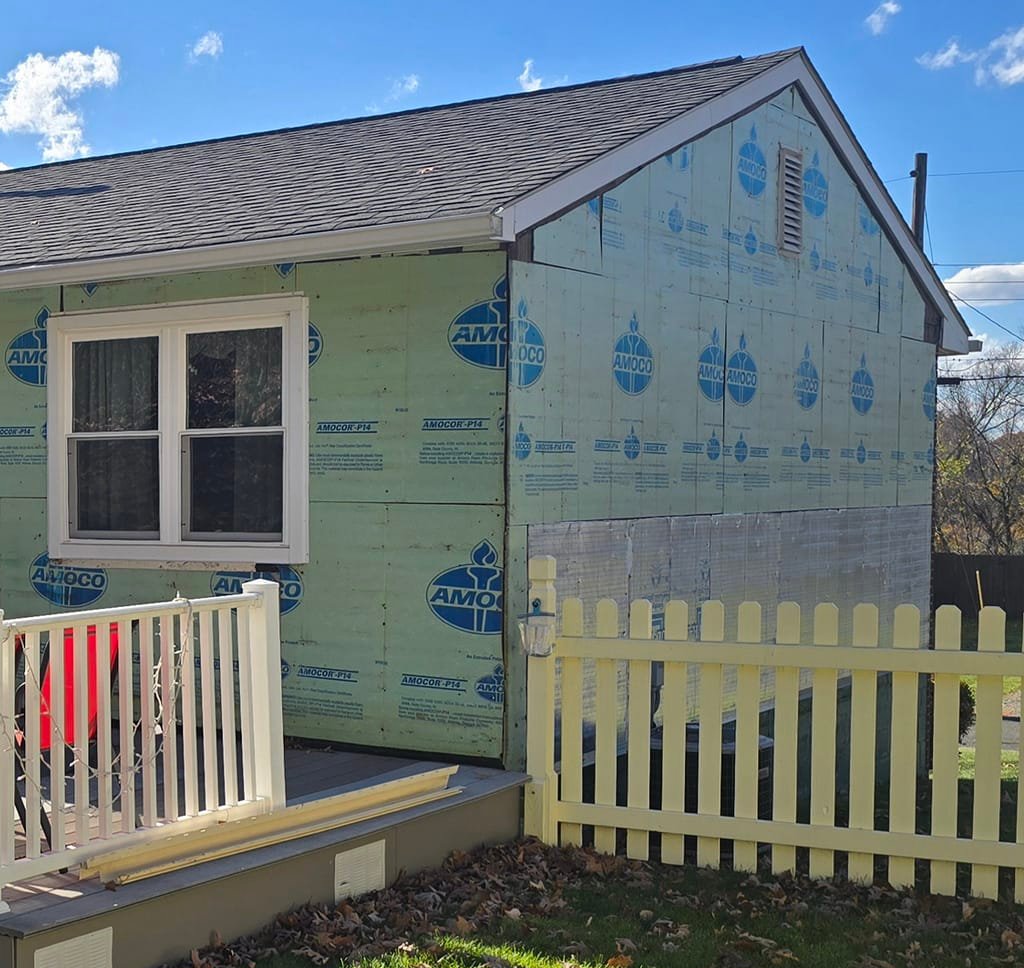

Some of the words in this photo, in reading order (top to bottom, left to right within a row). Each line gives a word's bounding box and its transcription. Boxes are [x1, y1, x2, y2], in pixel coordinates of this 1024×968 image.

[613, 355, 653, 375] AMOCO
[699, 365, 724, 382] AMOC
[726, 369, 757, 387] AMOCO
[850, 384, 874, 399] AMOCO
[32, 568, 105, 588] AMOCO
[430, 588, 503, 609] AMO
